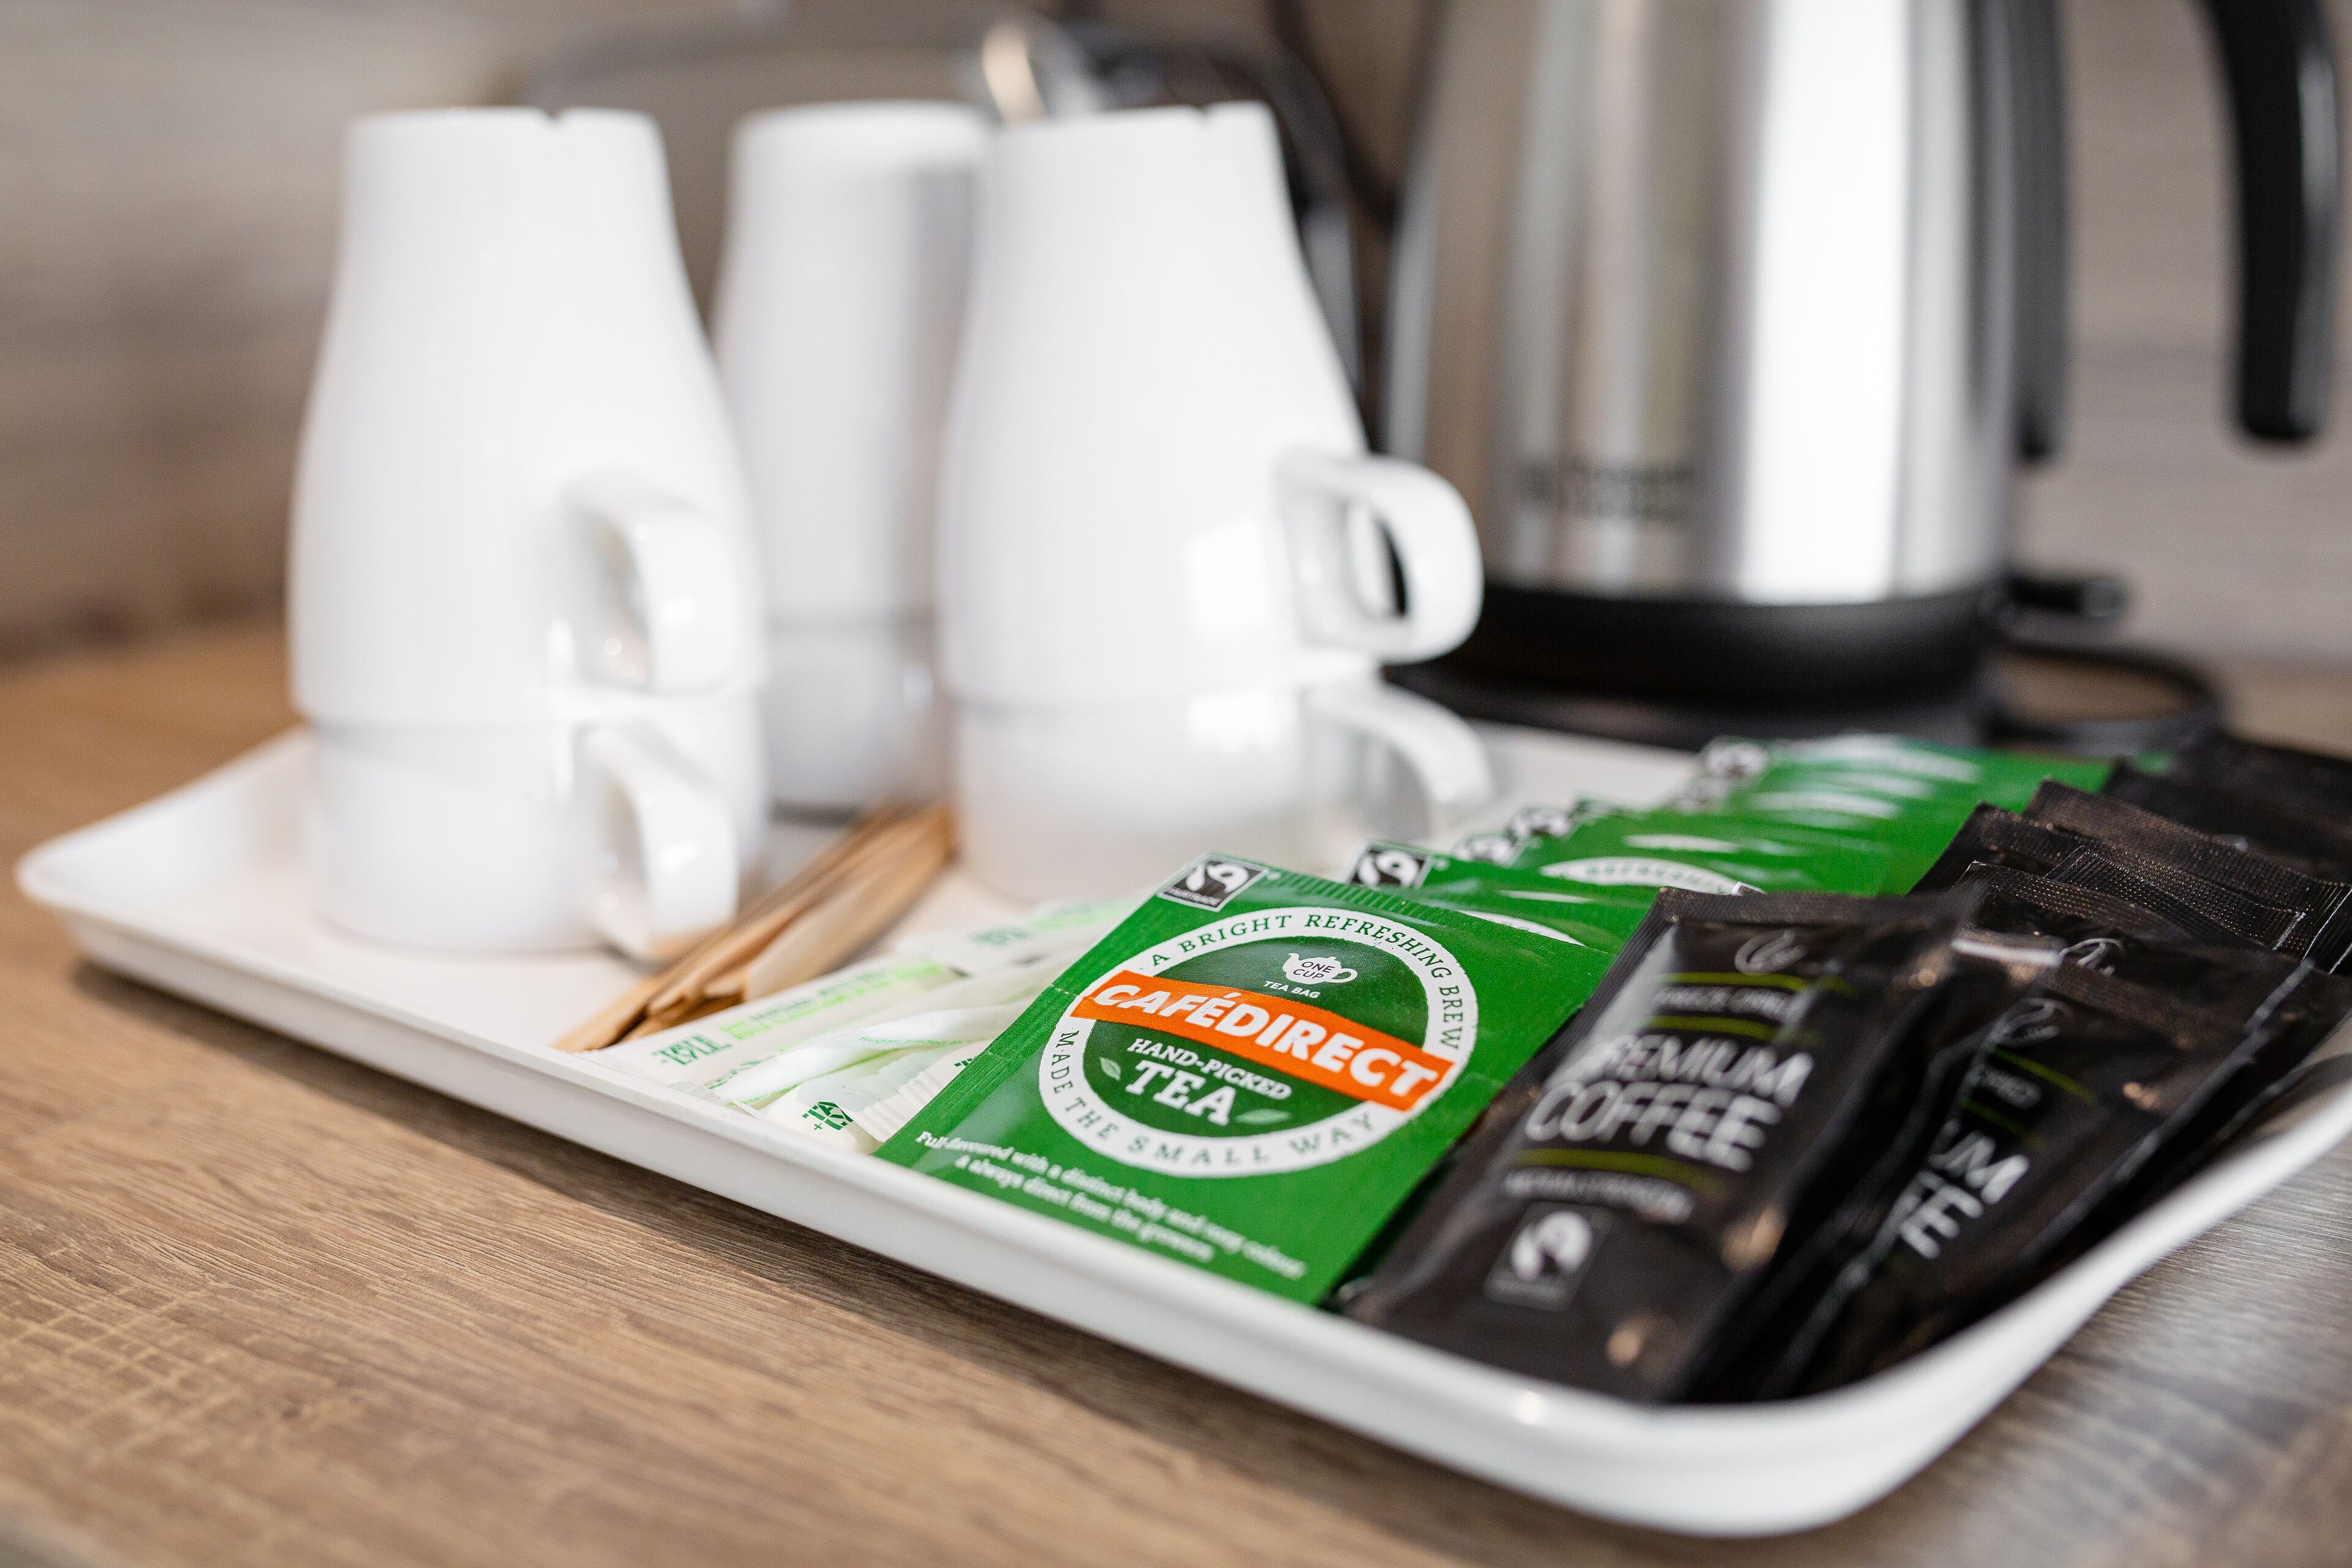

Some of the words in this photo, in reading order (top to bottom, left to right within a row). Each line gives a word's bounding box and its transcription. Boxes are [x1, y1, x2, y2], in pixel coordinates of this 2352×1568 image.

[1152, 954, 1170, 967] A
[1178, 915, 1292, 952] BRIGHT
[1305, 914, 1452, 979] REFRESHING
[1439, 984, 1463, 1050] BREW
[1293, 969, 1324, 979] CUP
[1301, 961, 1335, 973] ONE
[1264, 981, 1289, 992] TEA
[1291, 987, 1321, 999] BAG
[1050, 1030, 1080, 1095] MADE
[1093, 985, 1439, 1097] CAFÉDIRECT
[1126, 1038, 1294, 1101] HAND-PICKED
[1125, 1059, 1237, 1126] TEA
[1064, 1097, 1119, 1140] THE
[1289, 1111, 1373, 1156] WAY
[1524, 1080, 1782, 1173] COFFEE
[1012, 1151, 1049, 1174] with
[1047, 1164, 1063, 1180] a
[1127, 1135, 1272, 1166] SMALL
